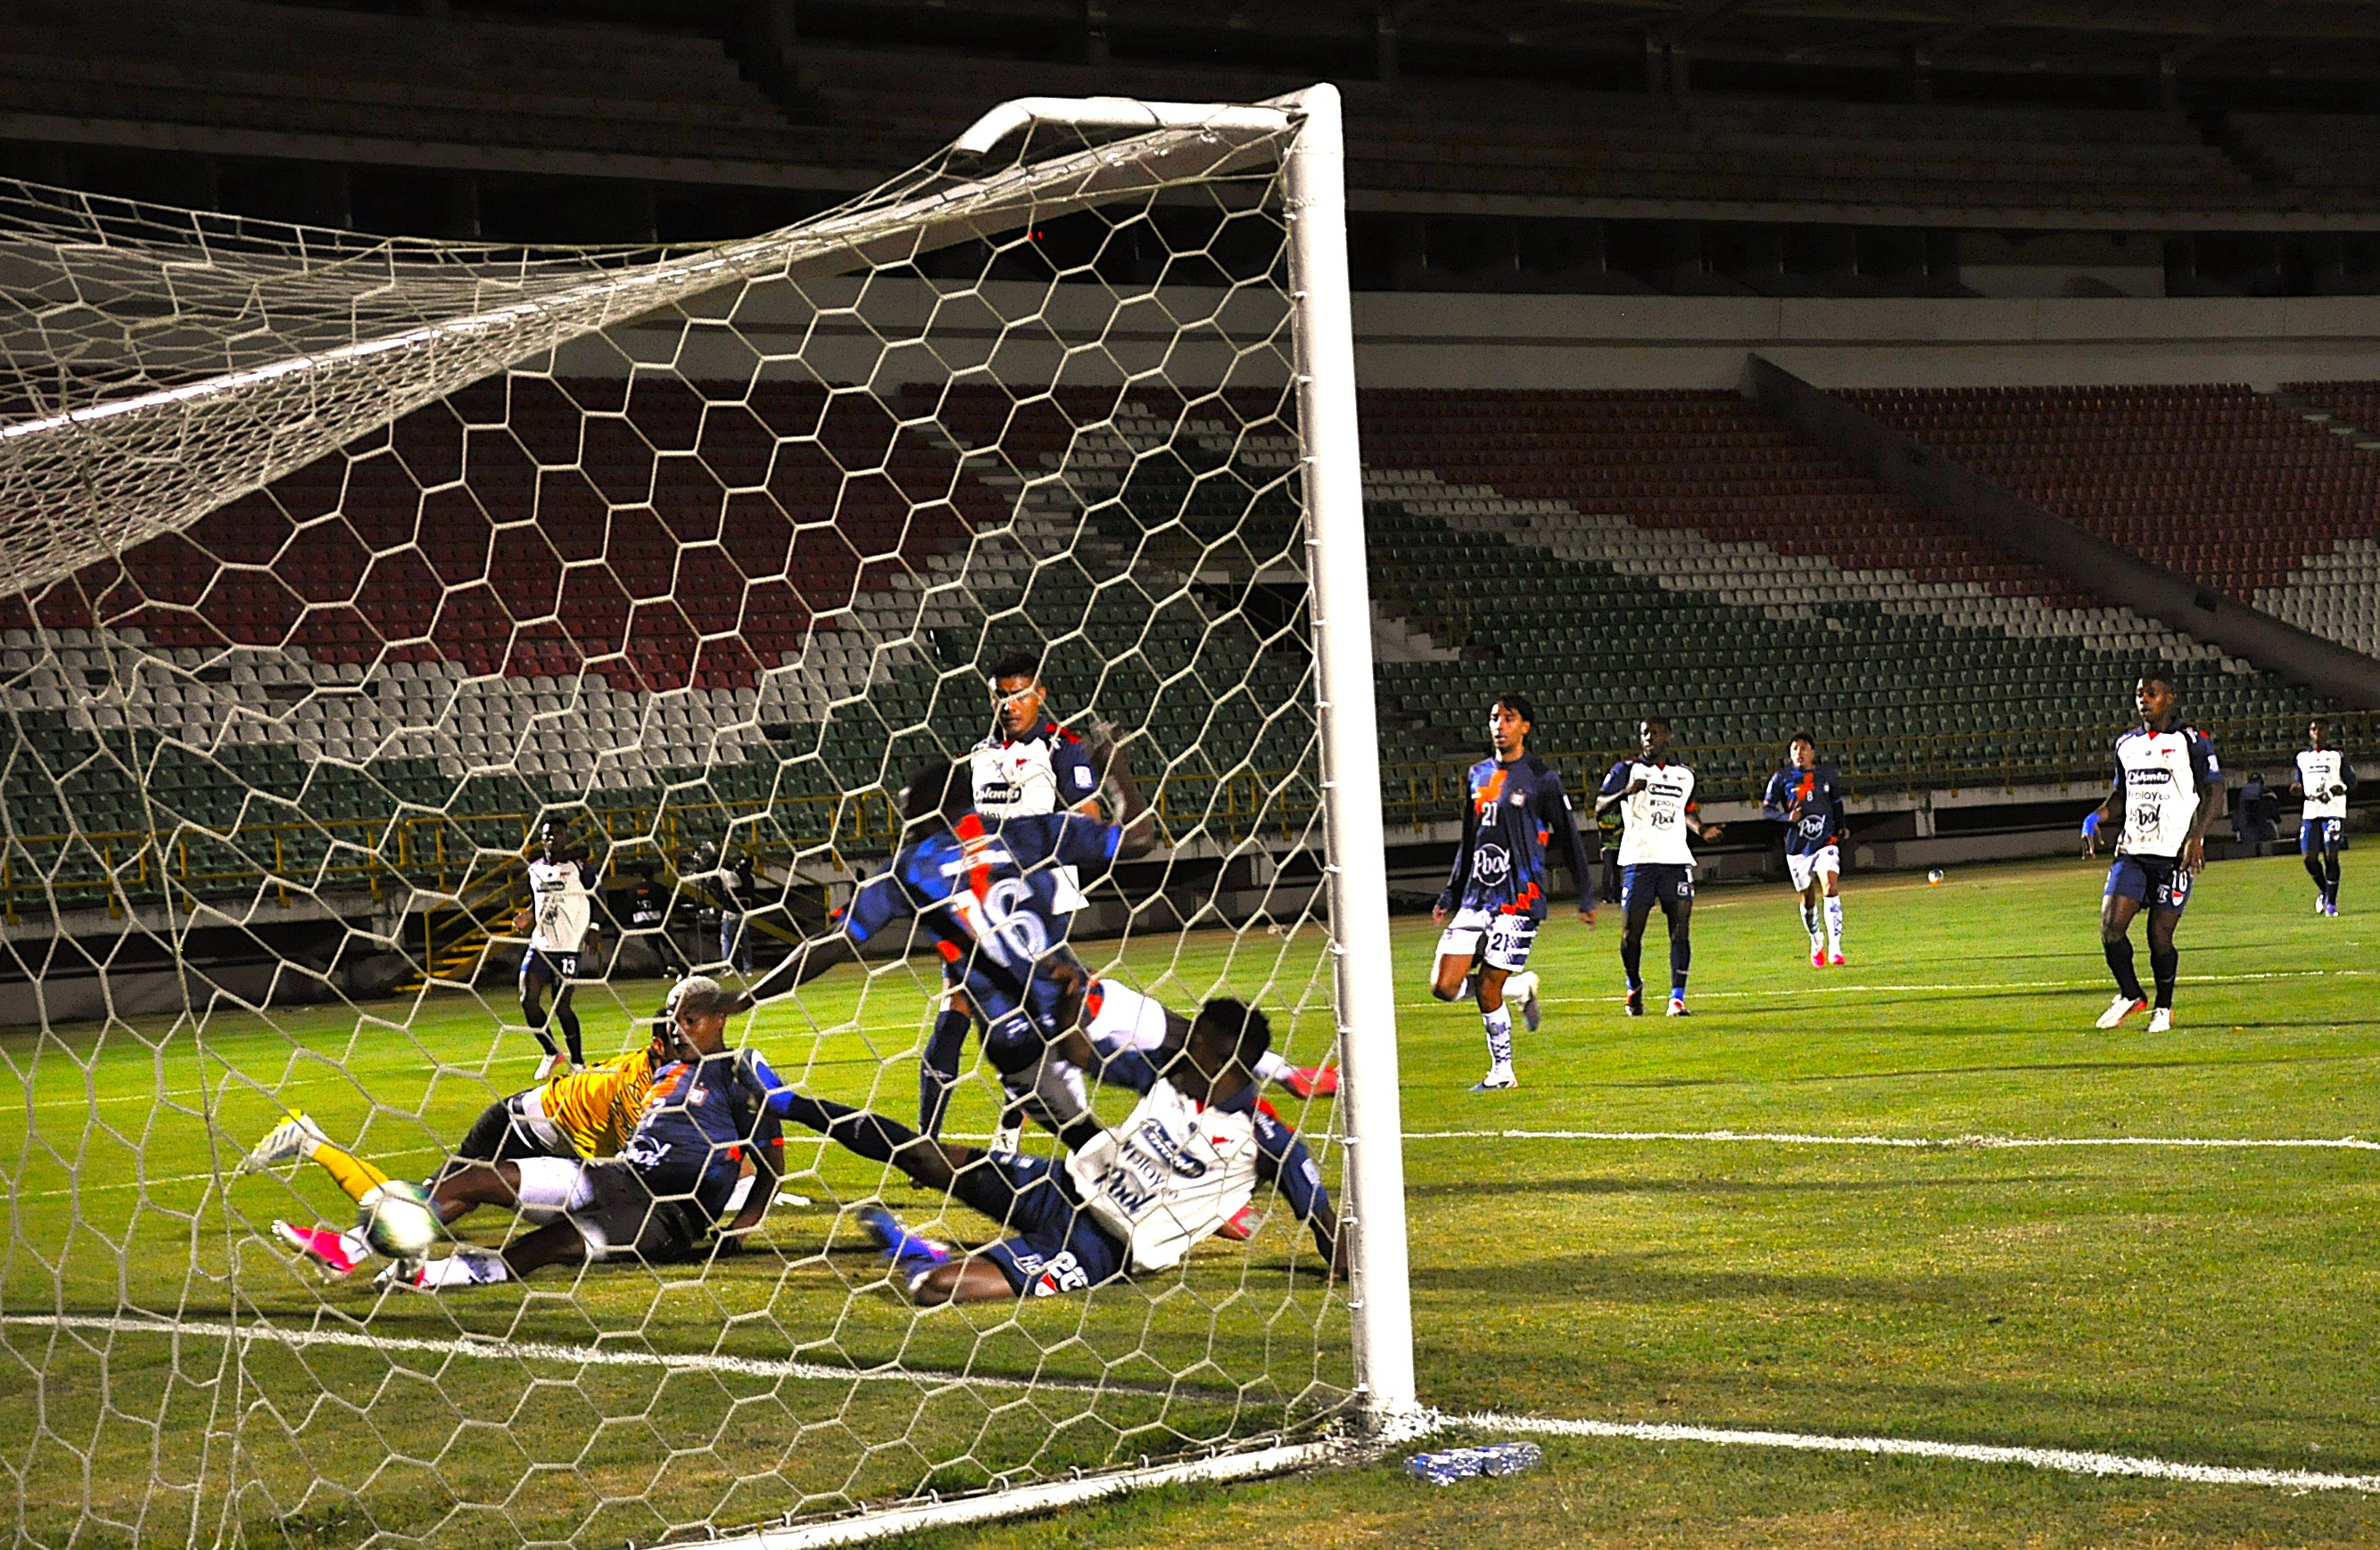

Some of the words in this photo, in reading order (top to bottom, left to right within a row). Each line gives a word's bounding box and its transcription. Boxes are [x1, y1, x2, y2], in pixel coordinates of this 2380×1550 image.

[1806, 790, 1814, 802] 8
[1482, 802, 1498, 826] 21
[2326, 819, 2341, 831] 20
[1797, 814, 1826, 837] Pool
[1473, 848, 1510, 878] Pool
[2172, 870, 2188, 892] 10
[951, 878, 1047, 967] 16
[1491, 932, 1509, 952] 21
[561, 958, 576, 974] 13
